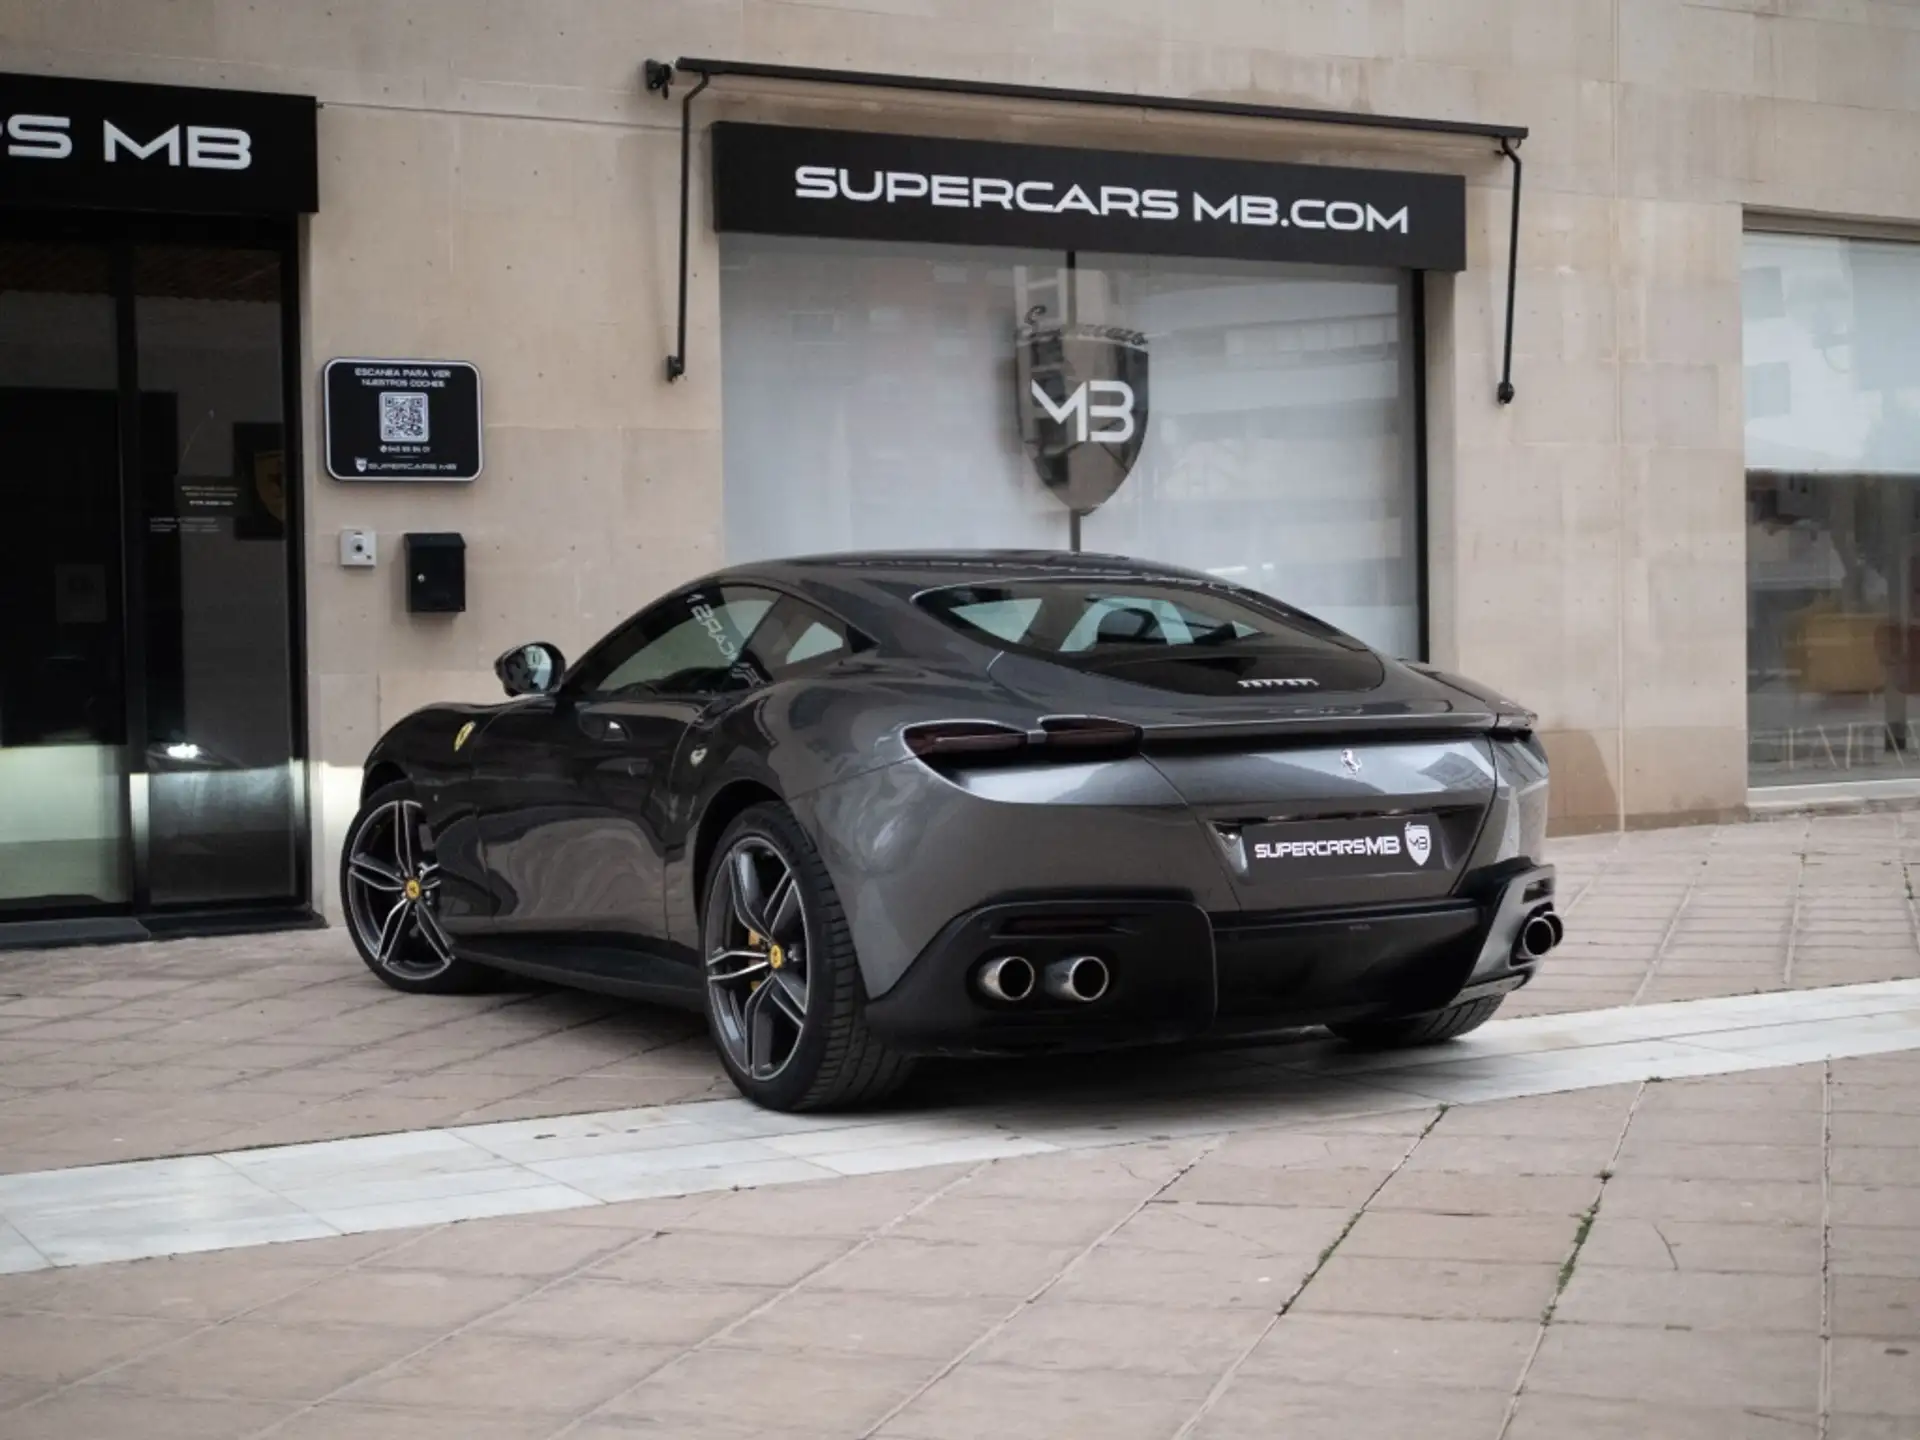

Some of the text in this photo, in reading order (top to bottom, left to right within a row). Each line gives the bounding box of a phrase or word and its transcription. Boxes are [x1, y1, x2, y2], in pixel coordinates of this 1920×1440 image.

[0, 113, 253, 170] S MB
[795, 165, 1409, 234] SUPERCARS MB.COM
[354, 367, 452, 378] ESCANEA PARA VER
[361, 379, 445, 388] NUESTROS COCHES
[1031, 378, 1135, 443] MB
[368, 463, 437, 471] SUPERCARS
